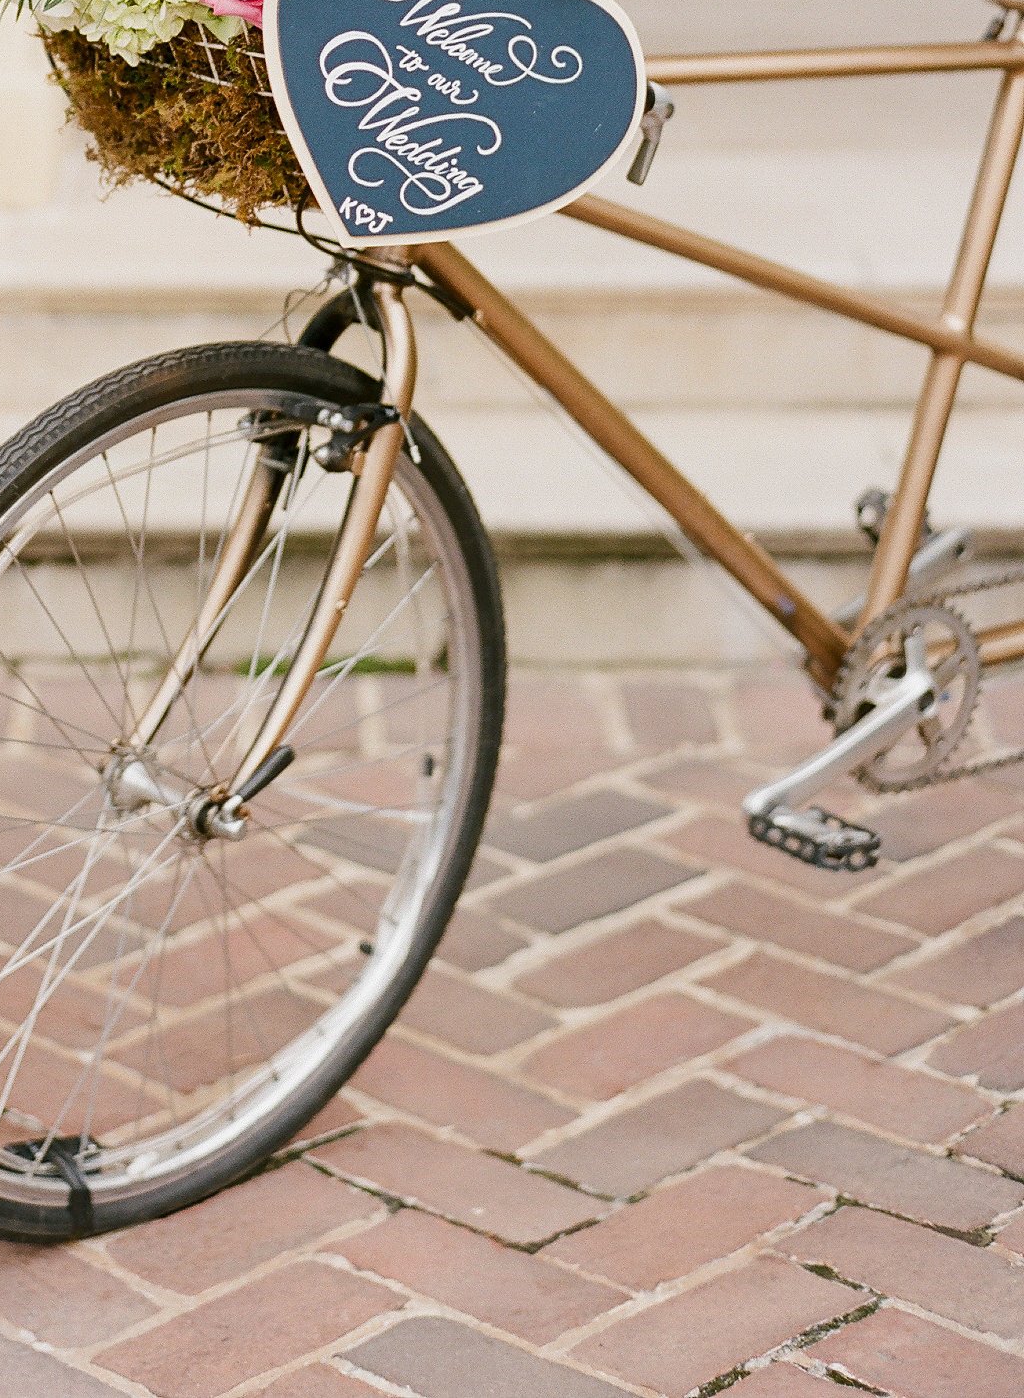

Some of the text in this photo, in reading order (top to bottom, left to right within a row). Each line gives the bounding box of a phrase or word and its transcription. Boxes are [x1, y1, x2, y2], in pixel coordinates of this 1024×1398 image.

[319, 30, 502, 216] Wedding
[396, 44, 479, 105] to our
